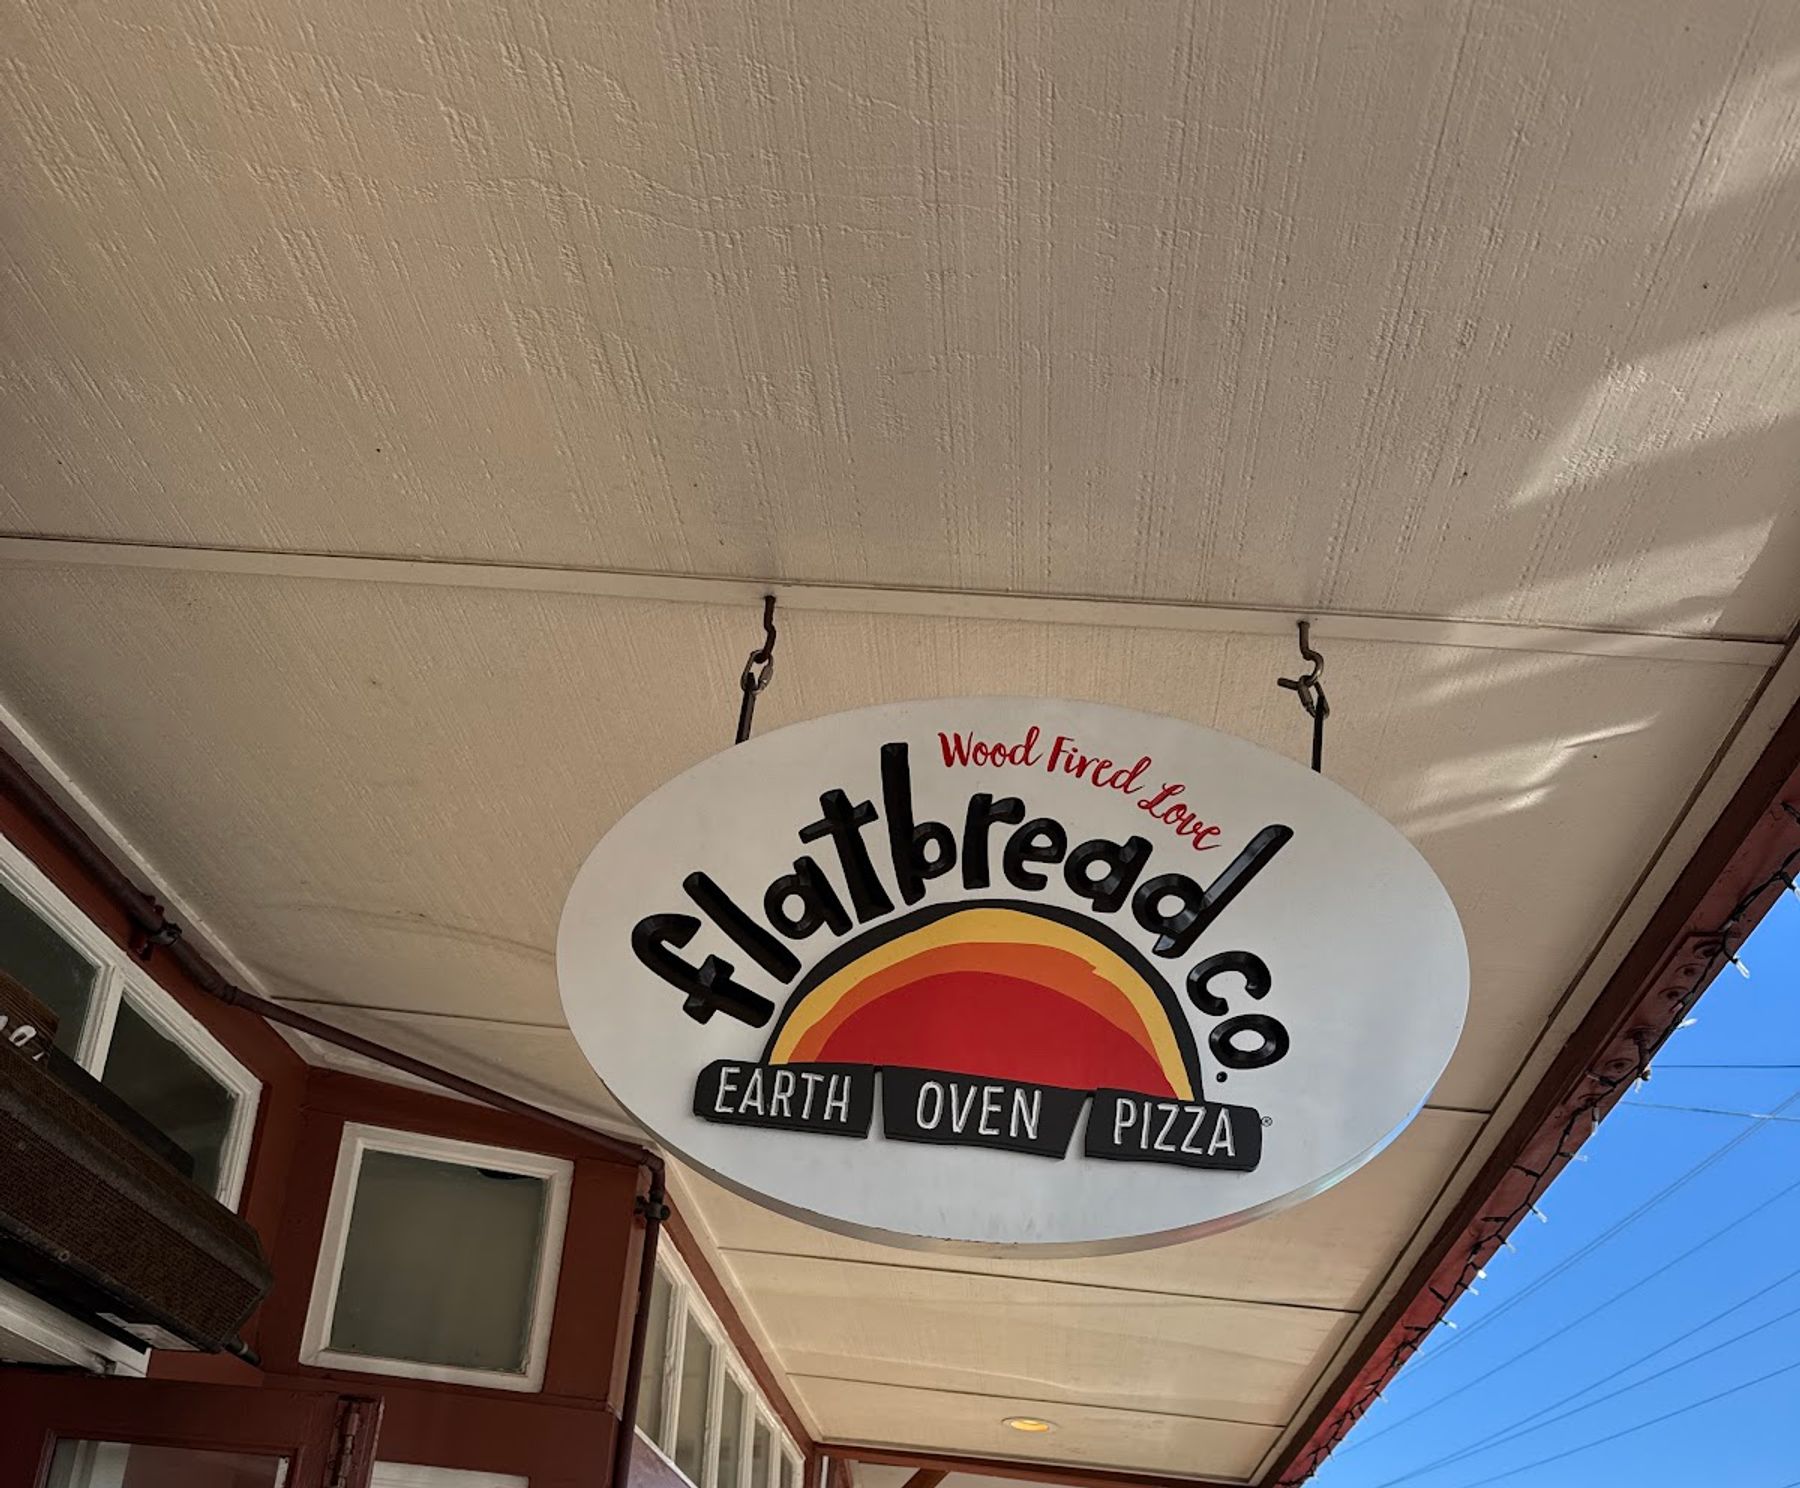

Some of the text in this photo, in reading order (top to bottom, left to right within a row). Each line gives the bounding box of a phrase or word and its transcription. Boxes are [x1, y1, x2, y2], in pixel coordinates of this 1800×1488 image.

[937, 725, 1222, 851] Wood Fired Love
[631, 742, 1294, 1028] flatbread
[713, 1066, 1236, 1157] EARTH OVEN PIZZA
